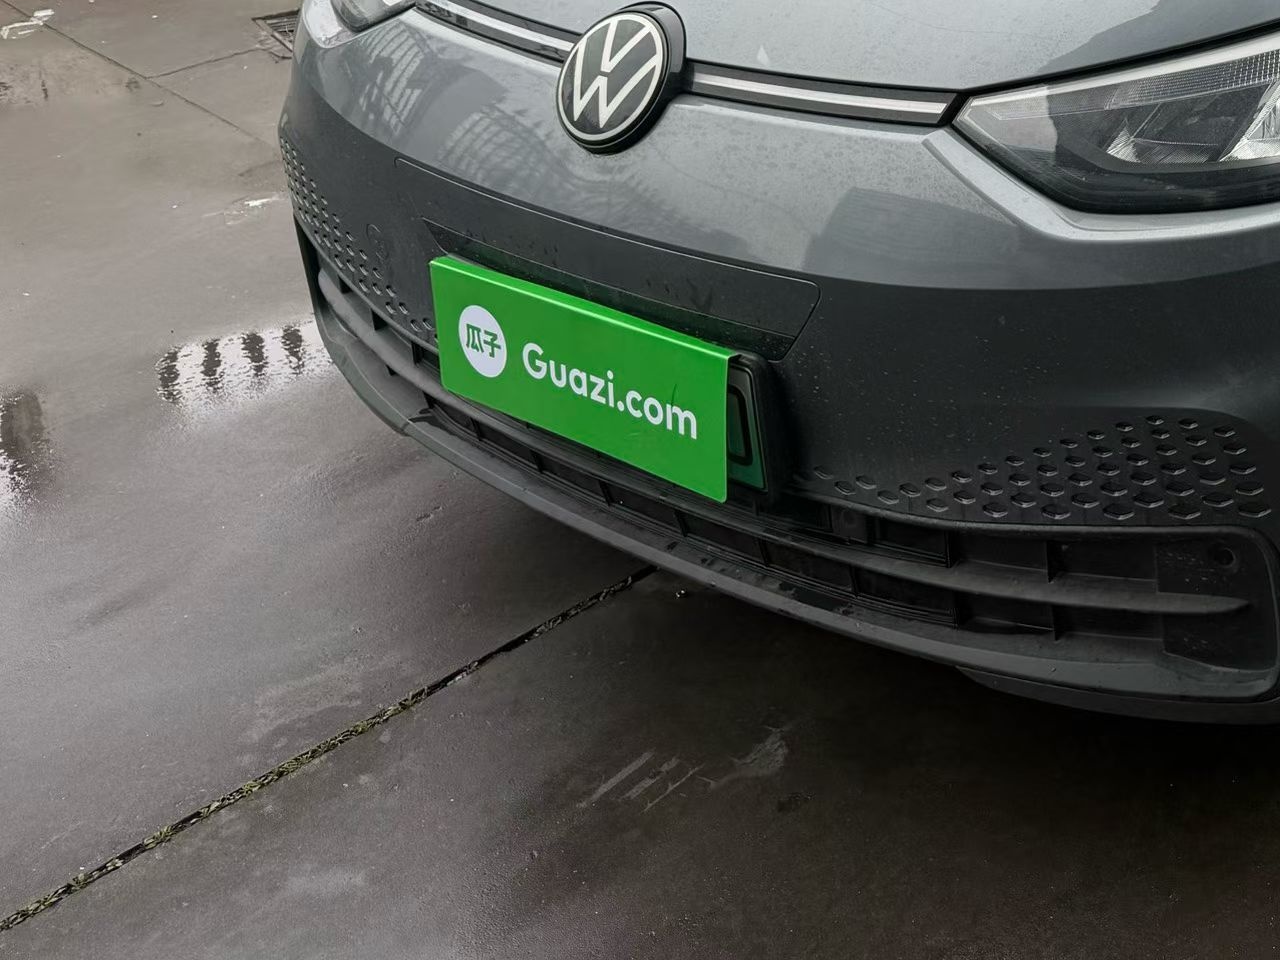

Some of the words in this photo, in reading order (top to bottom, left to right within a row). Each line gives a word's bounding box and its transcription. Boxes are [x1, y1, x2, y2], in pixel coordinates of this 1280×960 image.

[568, 16, 660, 131] VW
[465, 322, 502, 359] 瓜子
[522, 342, 698, 440] Guazi.com
